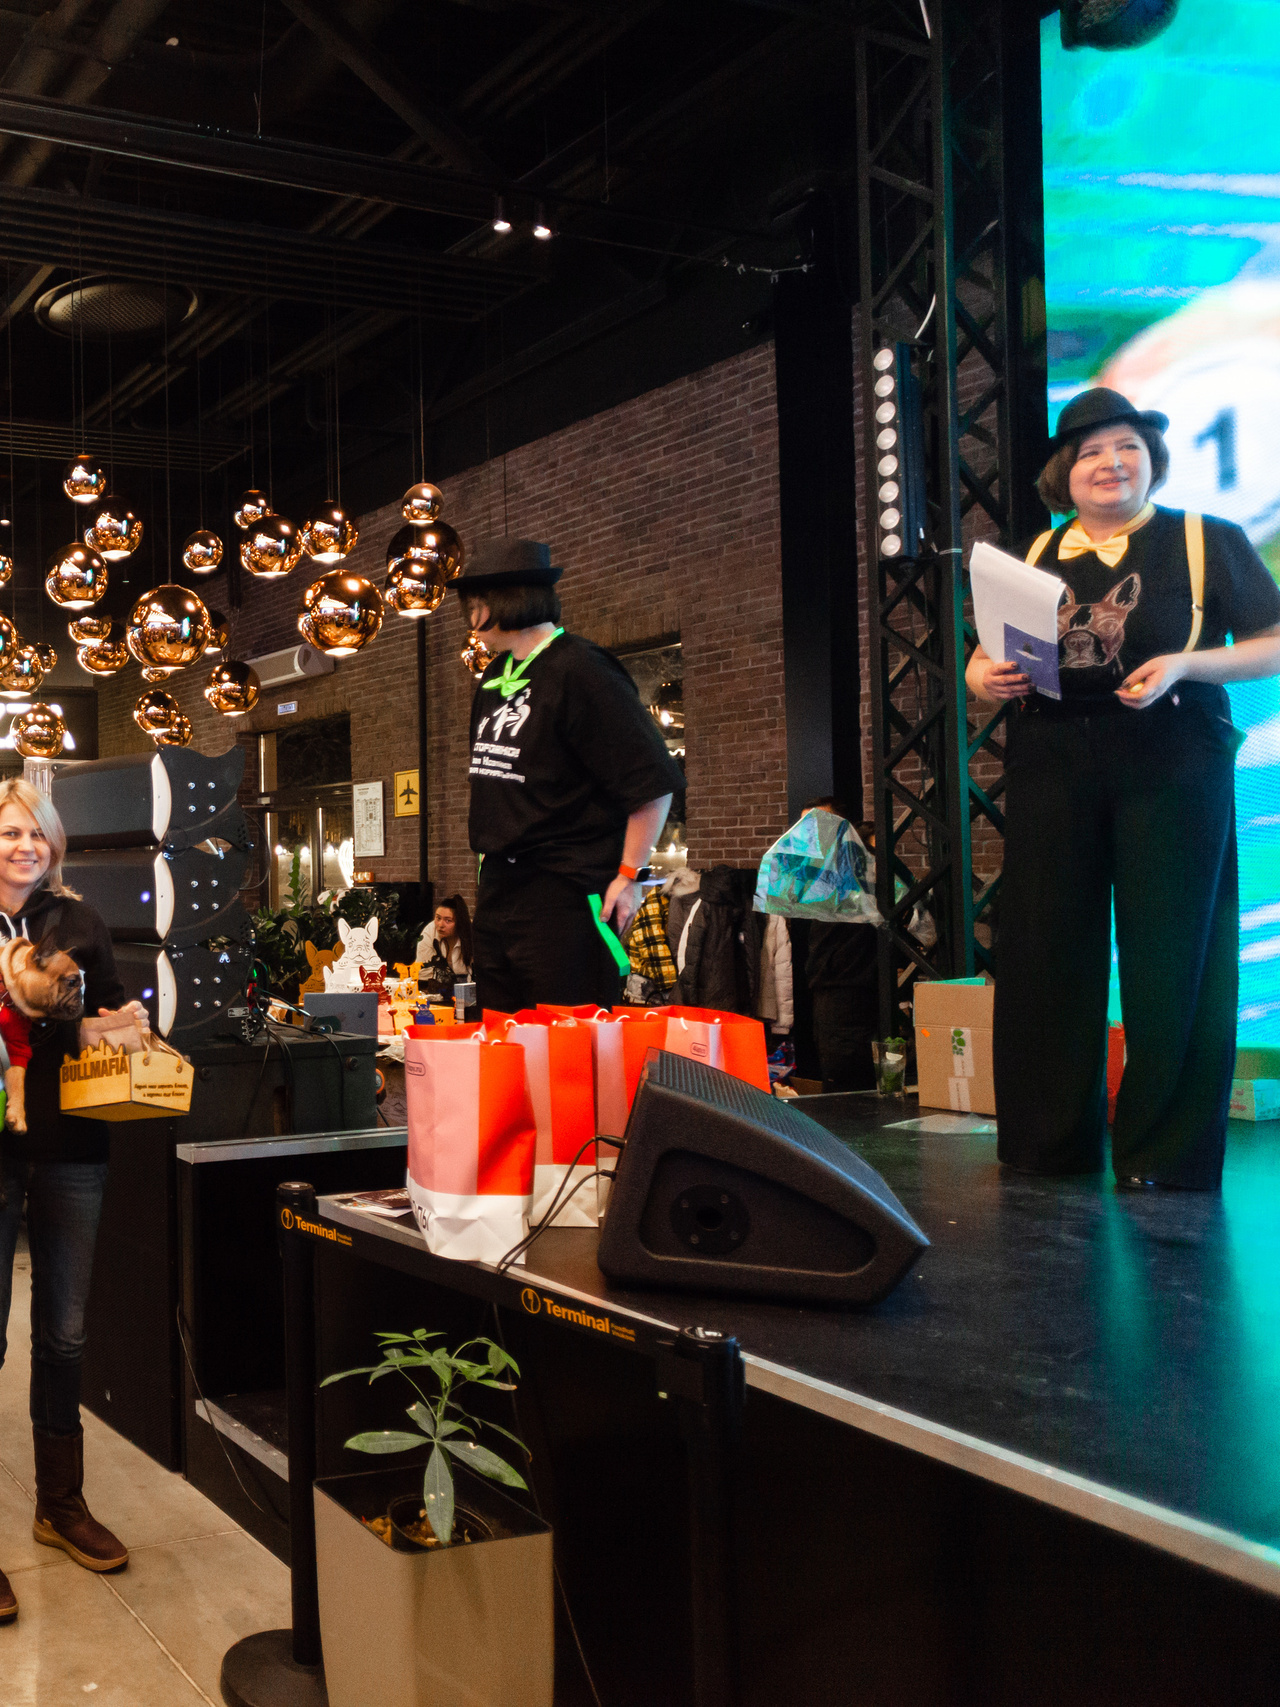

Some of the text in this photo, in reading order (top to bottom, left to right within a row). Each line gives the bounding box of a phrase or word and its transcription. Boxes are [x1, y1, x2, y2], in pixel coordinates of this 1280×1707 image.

[1192, 406, 1237, 491] 1
[61, 1056, 129, 1084] BULLMAFIA
[295, 1215, 337, 1241] Terminal
[543, 1297, 610, 1333] Terminal
